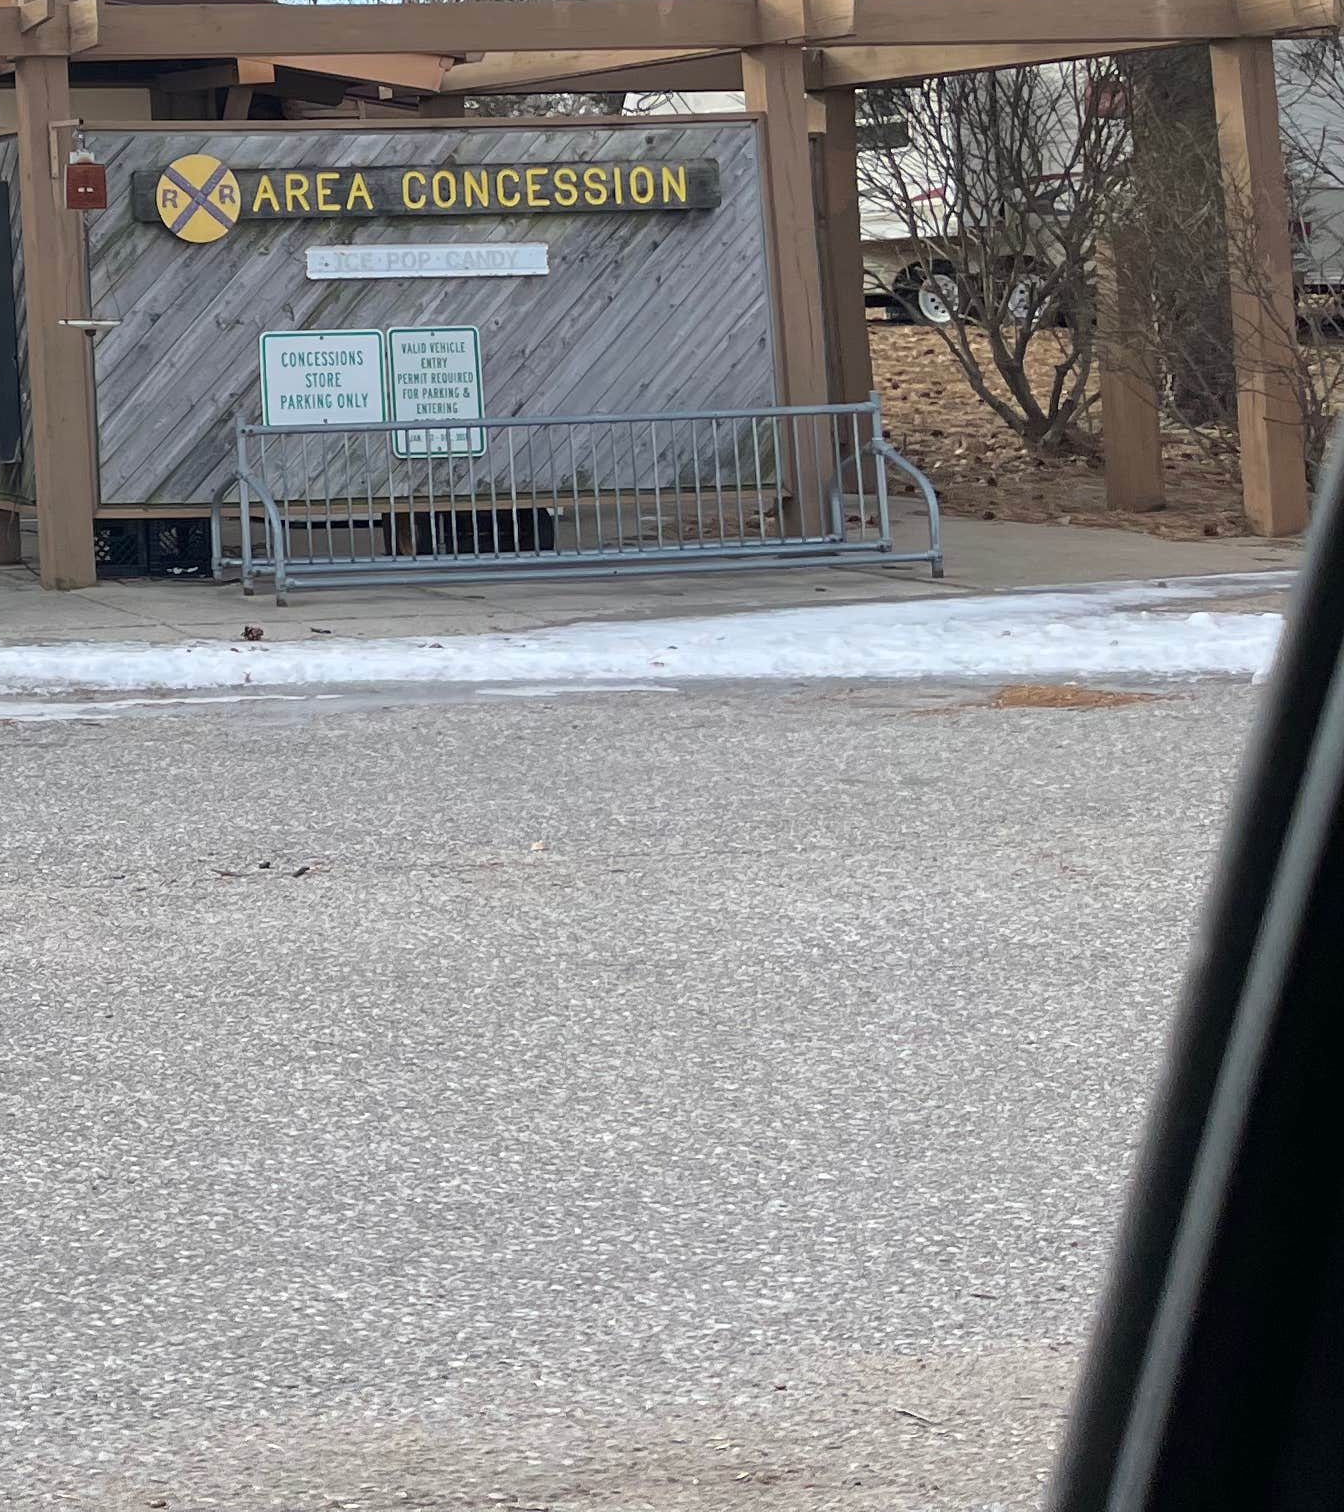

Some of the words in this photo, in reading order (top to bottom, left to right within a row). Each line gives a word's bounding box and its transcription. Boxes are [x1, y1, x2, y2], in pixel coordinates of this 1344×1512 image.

[162, 189, 179, 208] R
[219, 185, 236, 204] R
[252, 171, 374, 212] AREA
[401, 165, 687, 209] CONCESSION
[386, 250, 432, 271] POP
[445, 248, 520, 269] CANDY
[401, 342, 427, 355] VALID
[429, 341, 466, 354] VEHICLE
[281, 350, 364, 368] CONCESSIONS
[420, 357, 448, 369] ENTRY
[305, 372, 343, 388] STORE
[397, 373, 427, 385] PERMIT
[431, 371, 474, 384] REQUIRED
[280, 393, 332, 410] PARKING
[337, 392, 369, 408] ONLY
[402, 388, 419, 400] FOR
[422, 387, 460, 399] PARKING
[463, 387, 471, 398] &
[416, 402, 459, 415] ENTERING
